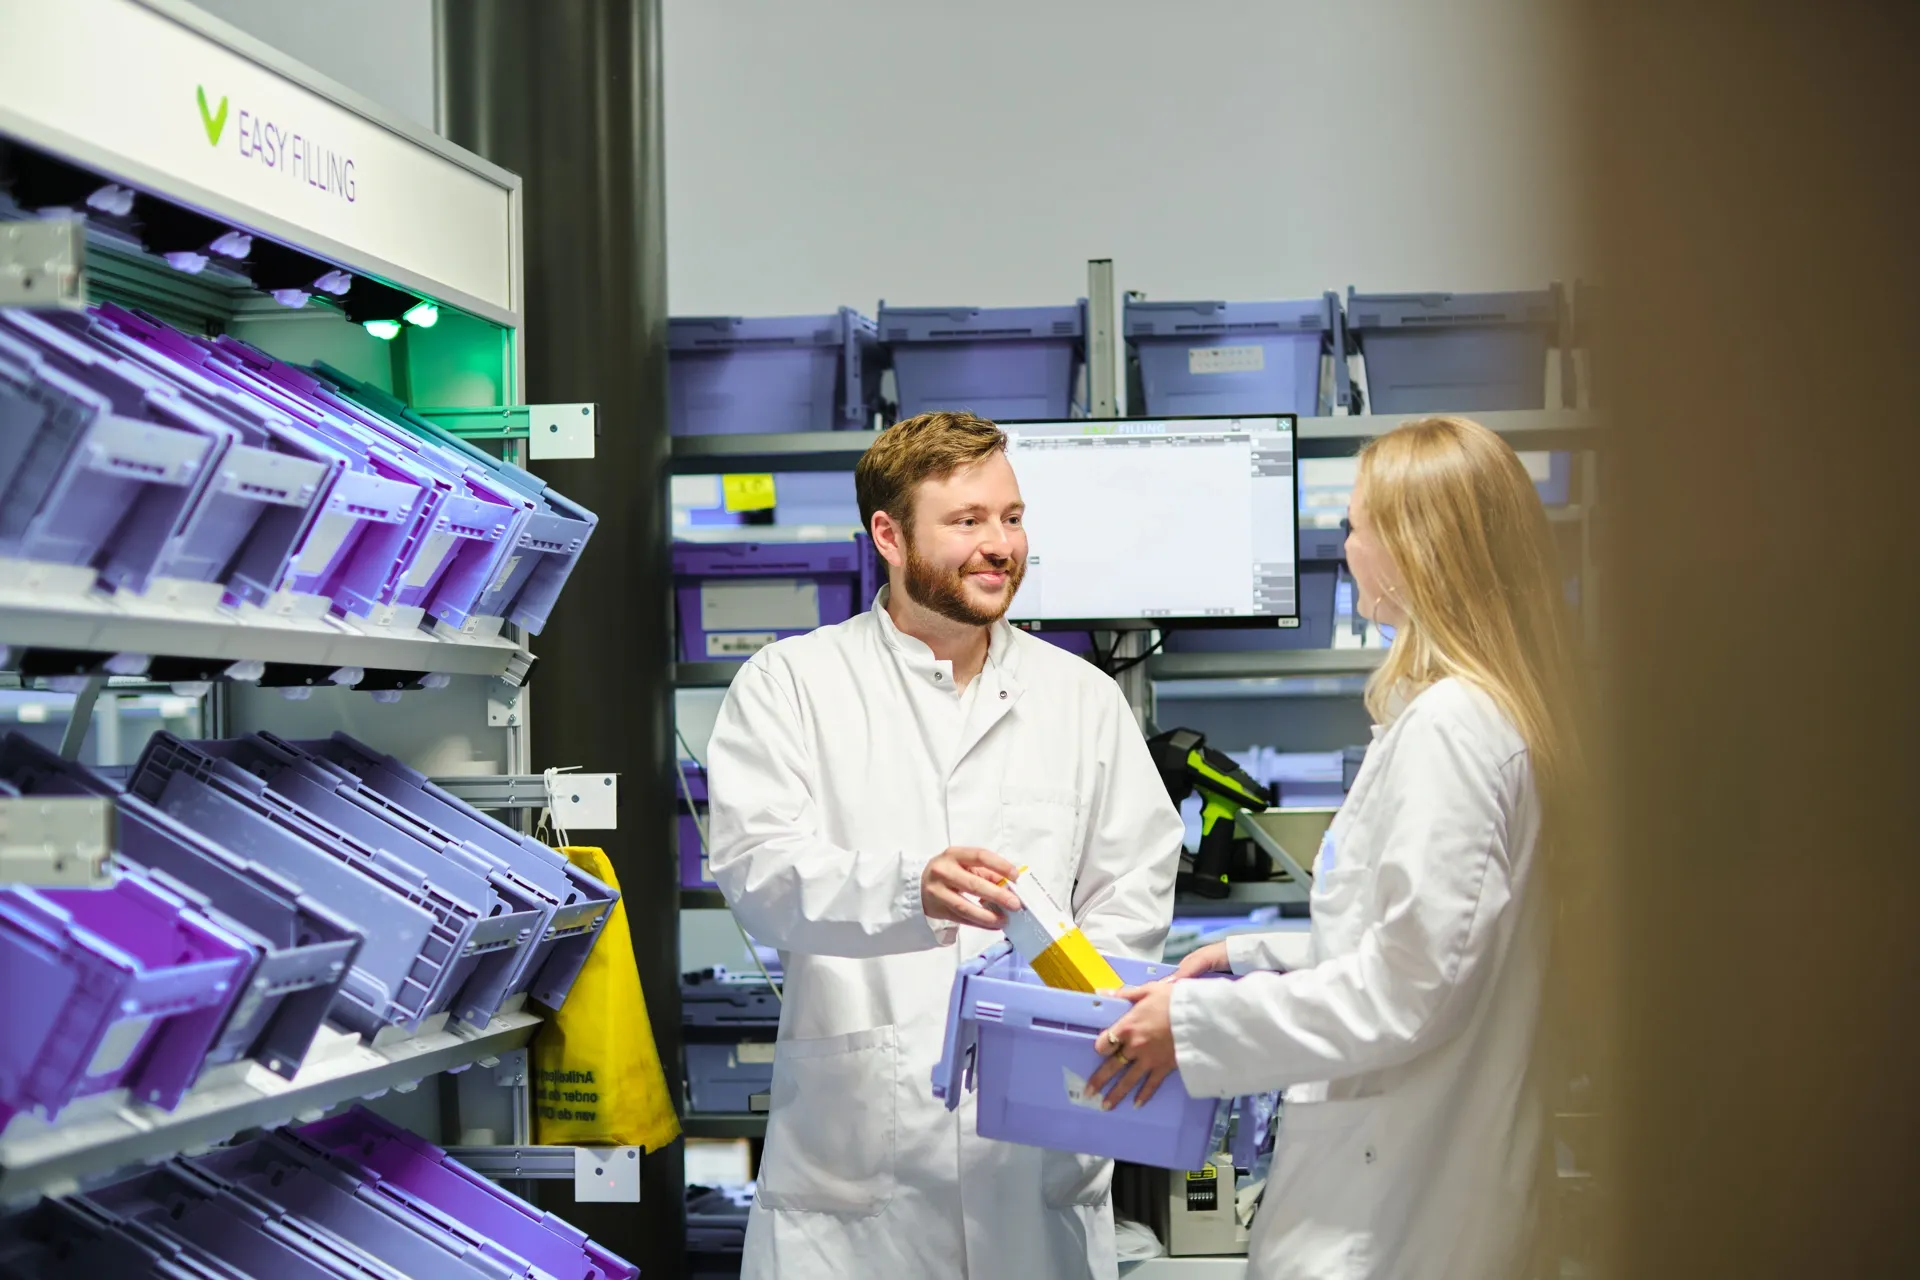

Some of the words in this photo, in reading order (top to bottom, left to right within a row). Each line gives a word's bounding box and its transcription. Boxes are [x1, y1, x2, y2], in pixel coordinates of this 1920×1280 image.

[239, 109, 287, 173] EASY
[293, 133, 355, 203] FILLING
[1119, 423, 1166, 434] FILLING
